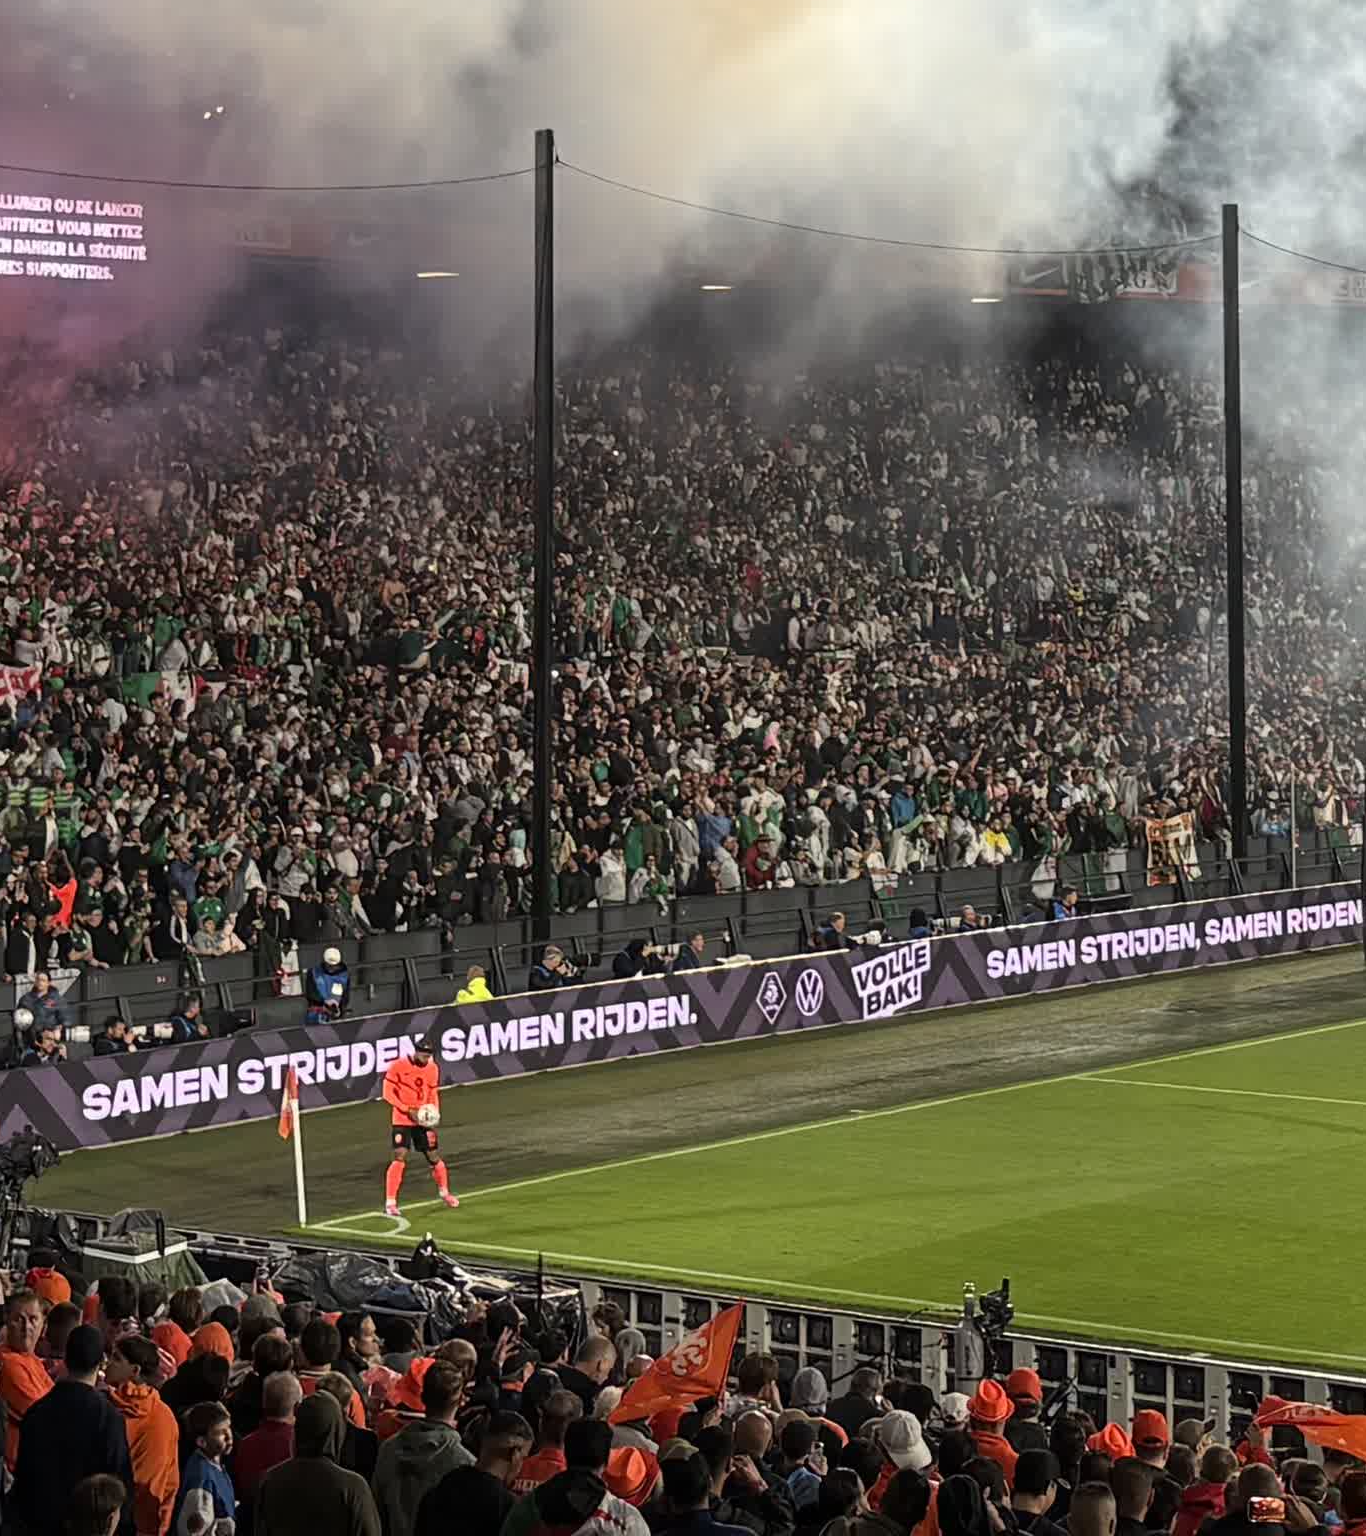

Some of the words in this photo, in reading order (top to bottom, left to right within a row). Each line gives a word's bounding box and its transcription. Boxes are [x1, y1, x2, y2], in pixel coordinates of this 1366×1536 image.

[53, 198, 74, 214] OU
[75, 200, 94, 215] DE
[95, 200, 143, 219] LANCER
[56, 219, 91, 237] VOUS
[93, 222, 143, 239] METTEZ
[13, 239, 67, 257] DANGER
[68, 242, 87, 257] LA
[986, 938, 1076, 979] SAMEN
[1080, 922, 1202, 965] STRIJDEN,
[1204, 909, 1284, 947] SAMEN
[856, 943, 928, 992] VOLLE
[865, 978, 920, 1021] BAK!
[82, 1063, 229, 1121] SAMEN
[440, 1011, 565, 1062] SAMEN
[572, 994, 699, 1043] RIJDEN.
